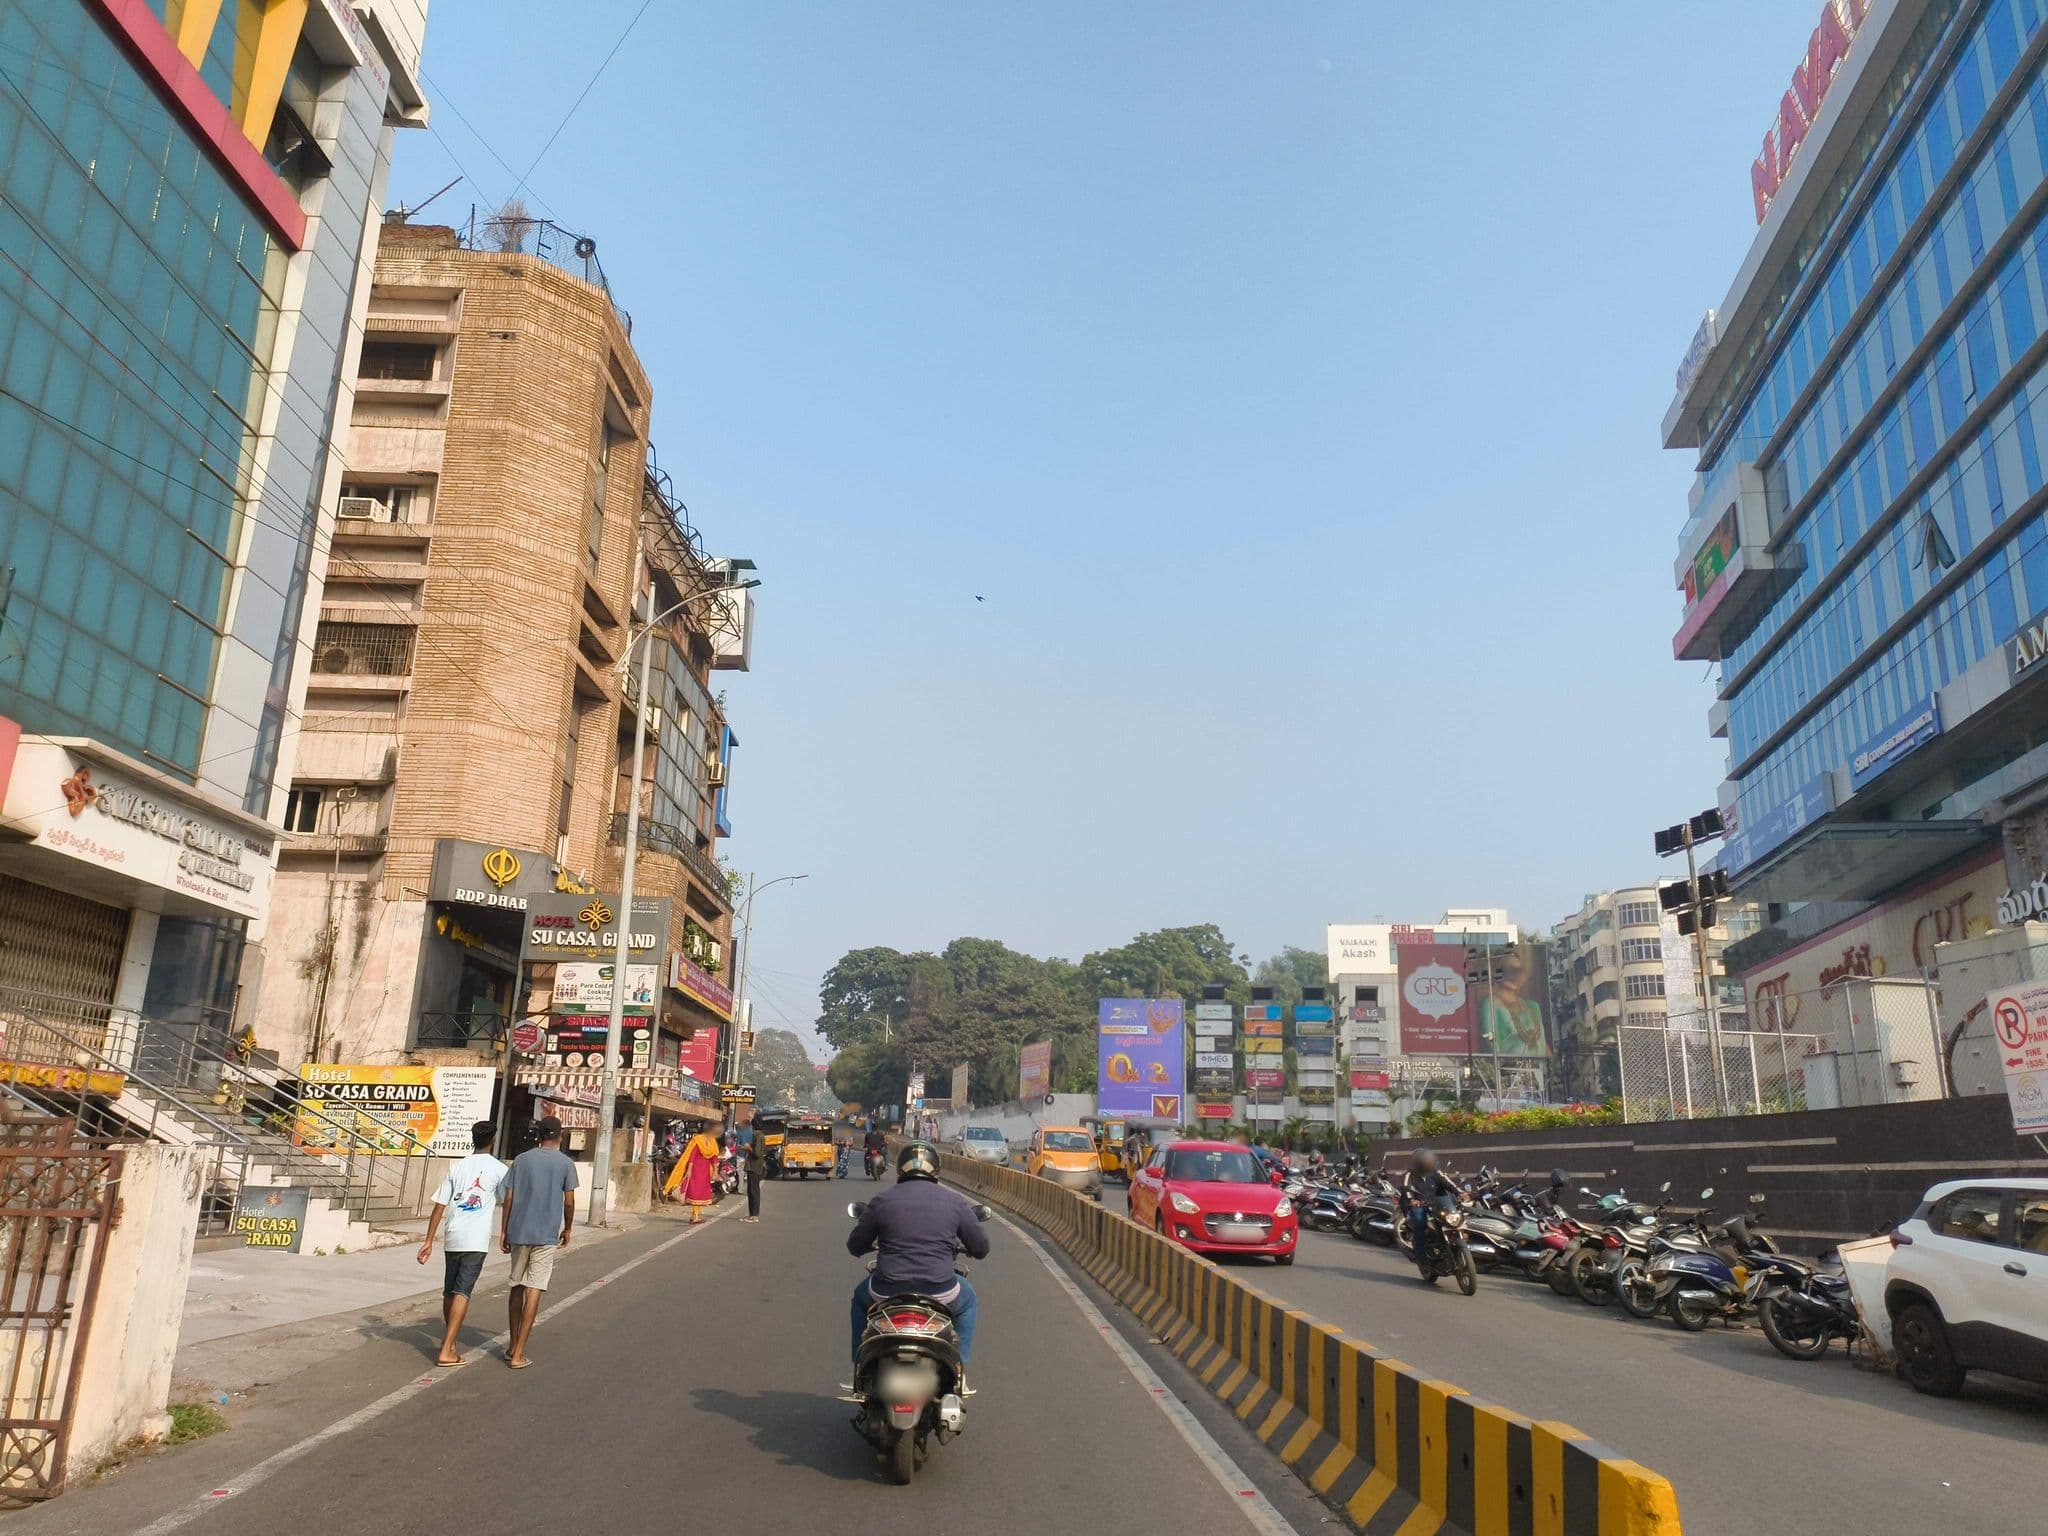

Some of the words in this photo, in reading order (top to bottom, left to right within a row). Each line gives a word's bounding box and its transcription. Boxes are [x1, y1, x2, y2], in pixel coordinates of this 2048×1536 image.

[176, 874, 206, 894] Wholesale
[455, 888, 485, 903] RDP
[533, 915, 575, 928] HOTEL
[1391, 925, 1411, 934] SIRI
[531, 929, 553, 945] SU
[556, 930, 597, 947] CASA
[602, 932, 656, 949] GAND
[1342, 949, 1376, 959] Akash
[587, 988, 611, 996] Cooking
[1414, 977, 1456, 997] GRT
[1366, 1009, 1378, 1017] LG
[2035, 1015, 2048, 1027] NO
[2025, 1047, 2042, 1058] FINE
[309, 1068, 352, 1082] Hotel
[330, 1084, 369, 1100] CASA
[373, 1085, 430, 1101] GRAND
[392, 1102, 406, 1110] Wifi
[575, 1108, 595, 1128] SALE
[241, 1206, 266, 1217] Hotel
[236, 1217, 257, 1230] SU
[259, 1218, 297, 1232] CASA
